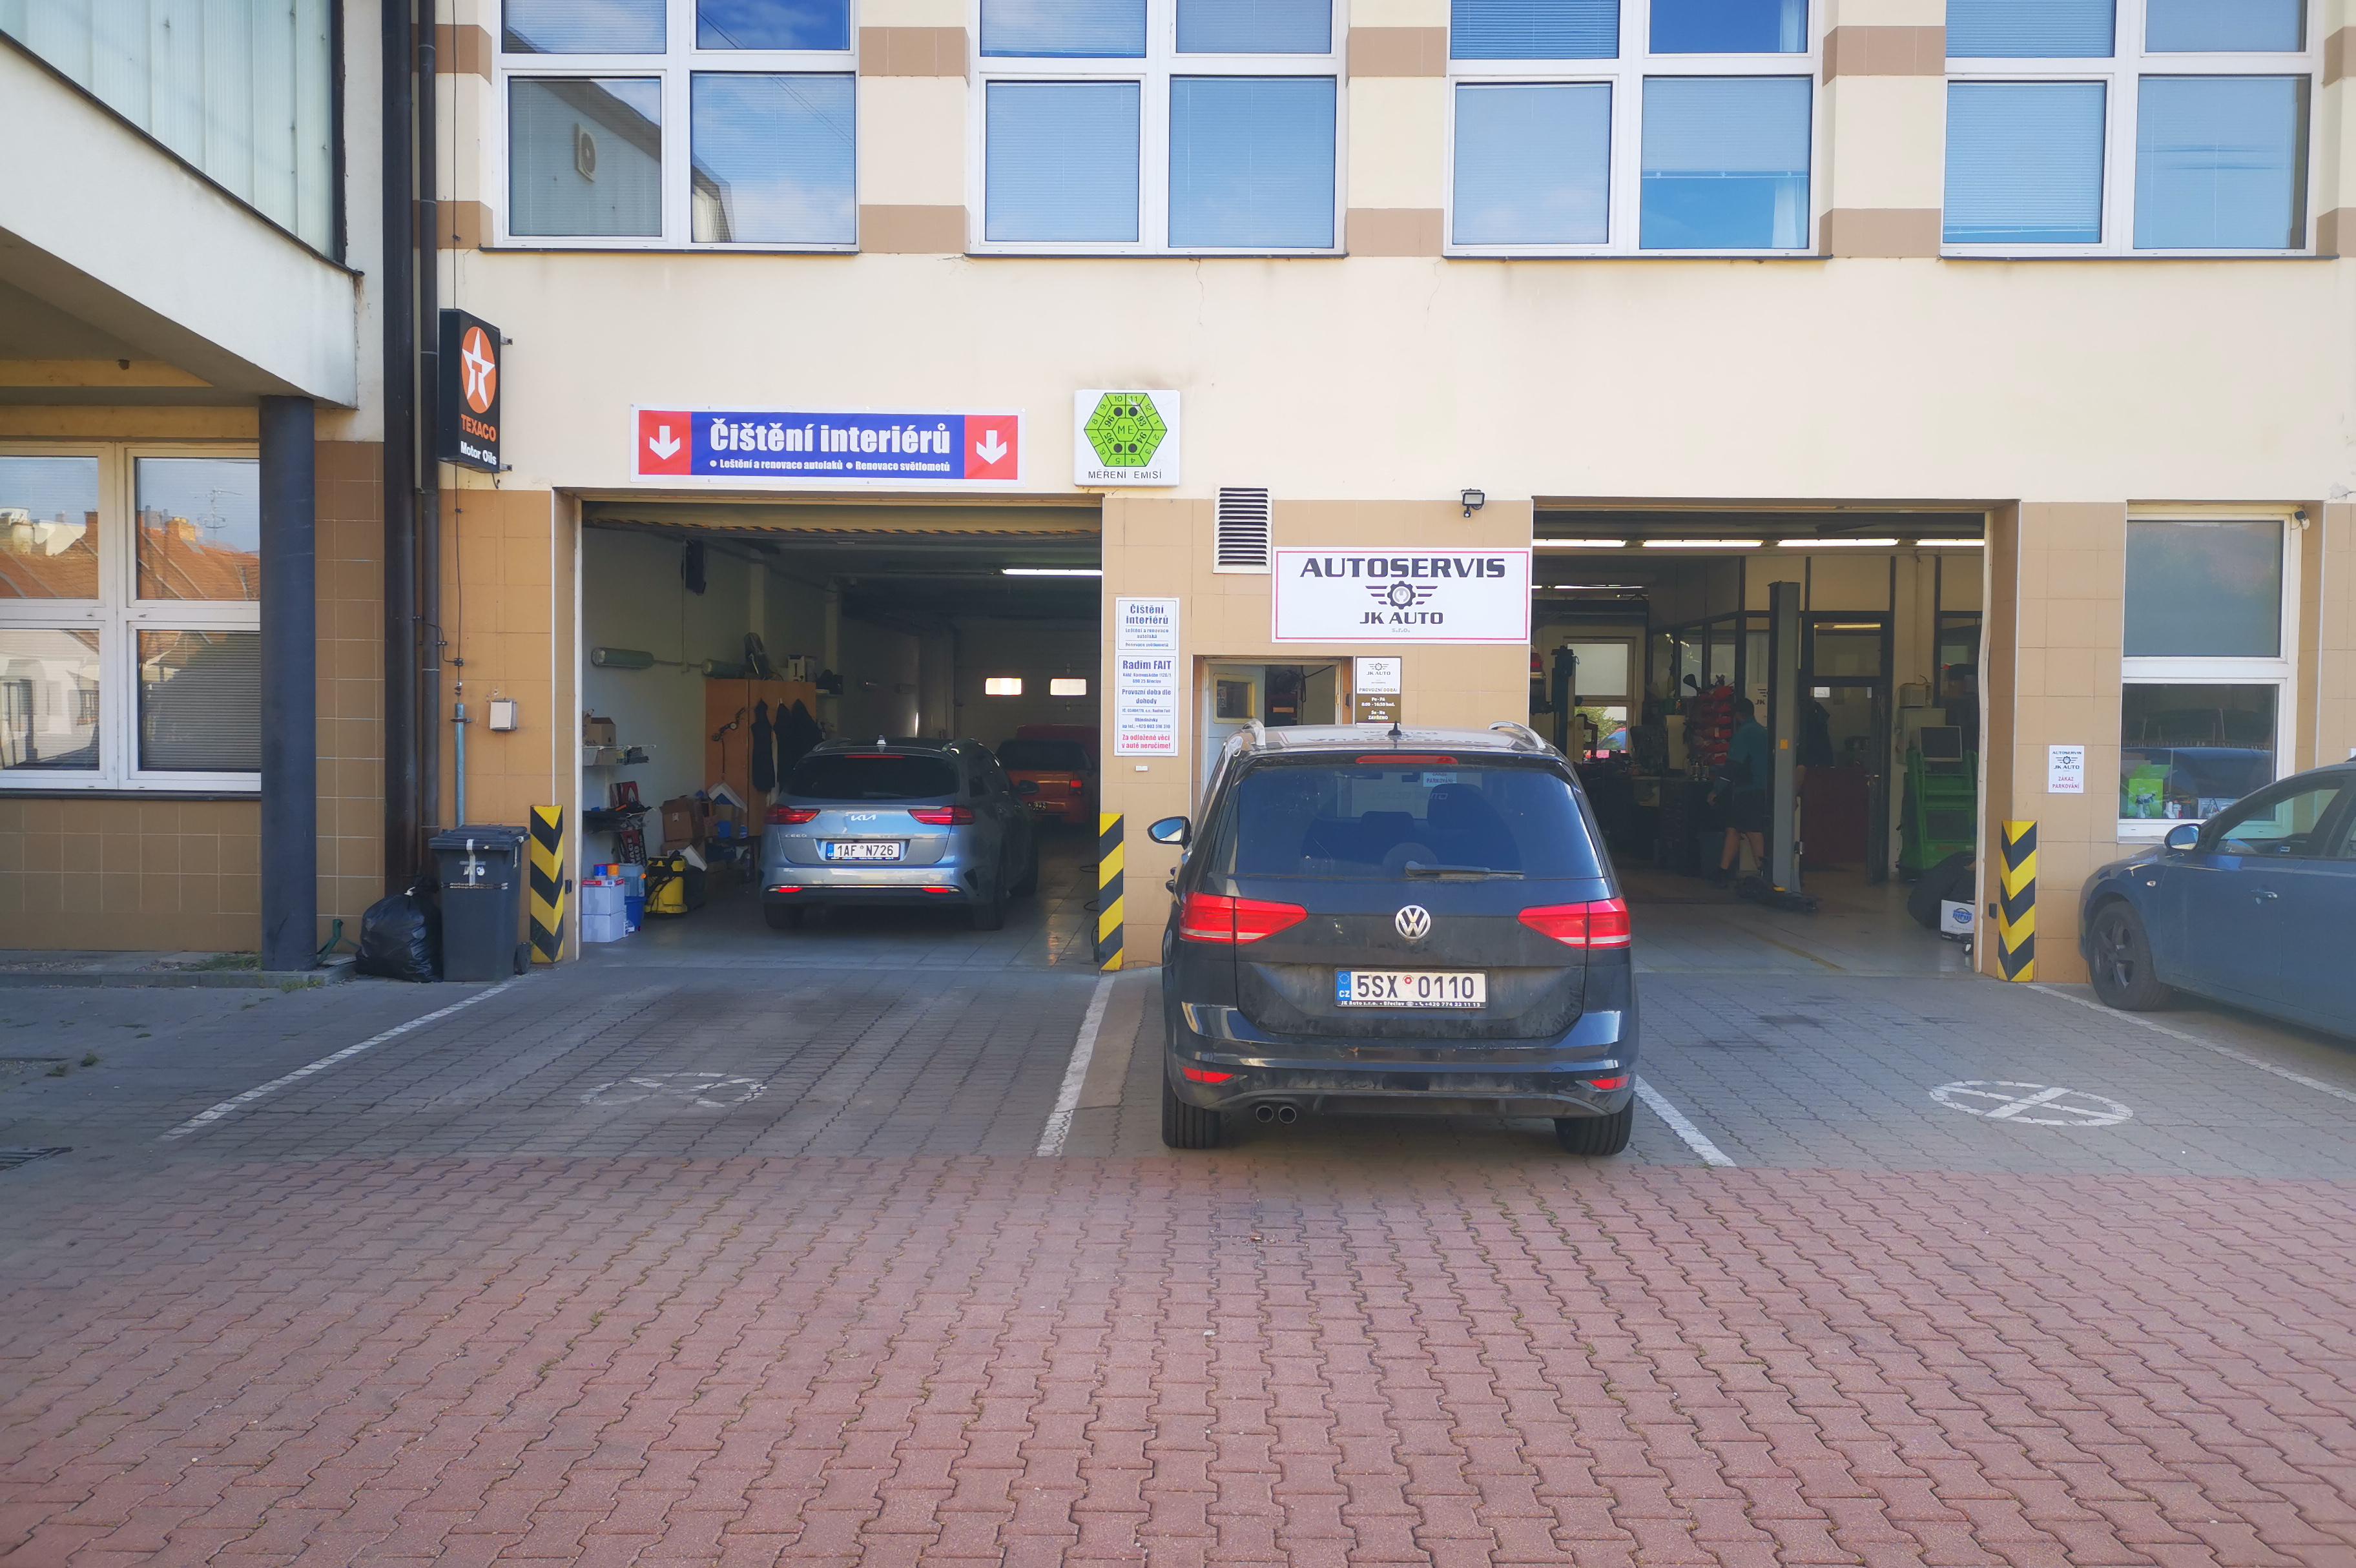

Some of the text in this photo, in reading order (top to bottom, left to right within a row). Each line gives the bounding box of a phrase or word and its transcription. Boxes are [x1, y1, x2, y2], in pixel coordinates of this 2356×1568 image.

[460, 414, 496, 442] TEXACO
[710, 418, 950, 453] Čištění interiérů
[460, 440, 497, 465] Motor Oils
[720, 459, 752, 468] Leštění
[804, 460, 843, 470] autolaků
[855, 461, 898, 471] Renovace
[900, 461, 950, 471] světlometů
[1088, 469, 1161, 479] MĚŘENÍ EMISÍ
[1300, 558, 1505, 578] AUTOSERVIS
[1130, 604, 1164, 614] Čištění
[1126, 615, 1168, 624] interiérů
[1359, 612, 1443, 624] JK AUTO
[1123, 660, 1172, 669] Radim FAIT
[838, 845, 856, 856] 1AF
[866, 845, 893, 856] N726
[1358, 975, 1398, 998] 5SX
[1418, 976, 1474, 998] 0110
